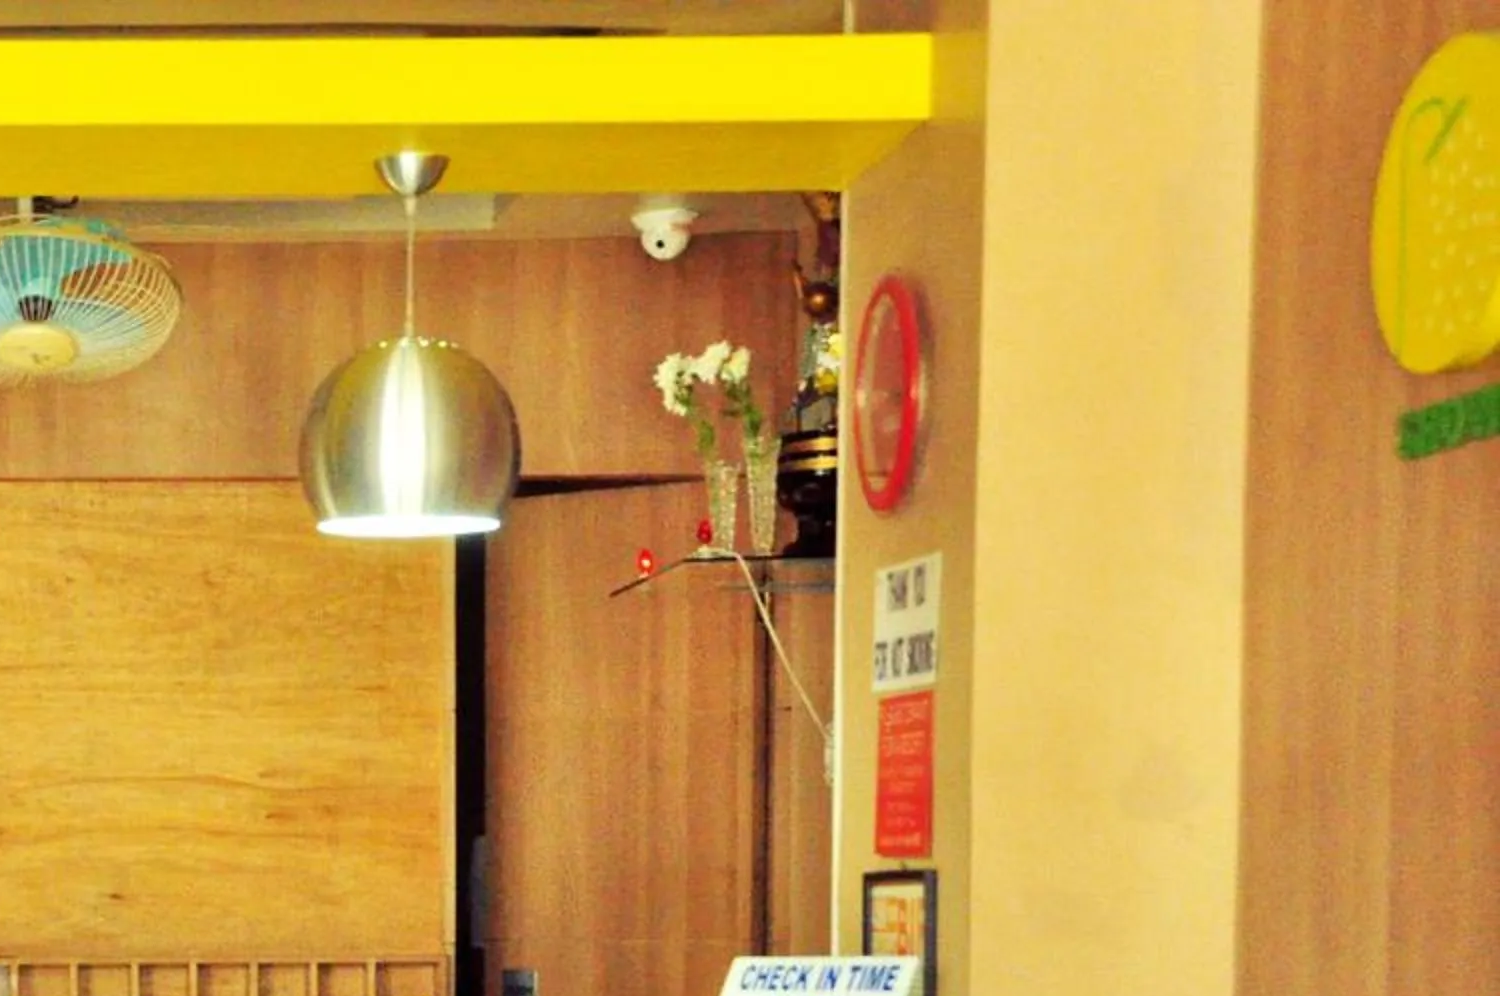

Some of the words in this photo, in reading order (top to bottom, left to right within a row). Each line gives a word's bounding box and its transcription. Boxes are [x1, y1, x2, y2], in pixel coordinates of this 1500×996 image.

[740, 965, 812, 991] CHECK
[815, 966, 842, 991] IN
[846, 965, 900, 992] TIME
